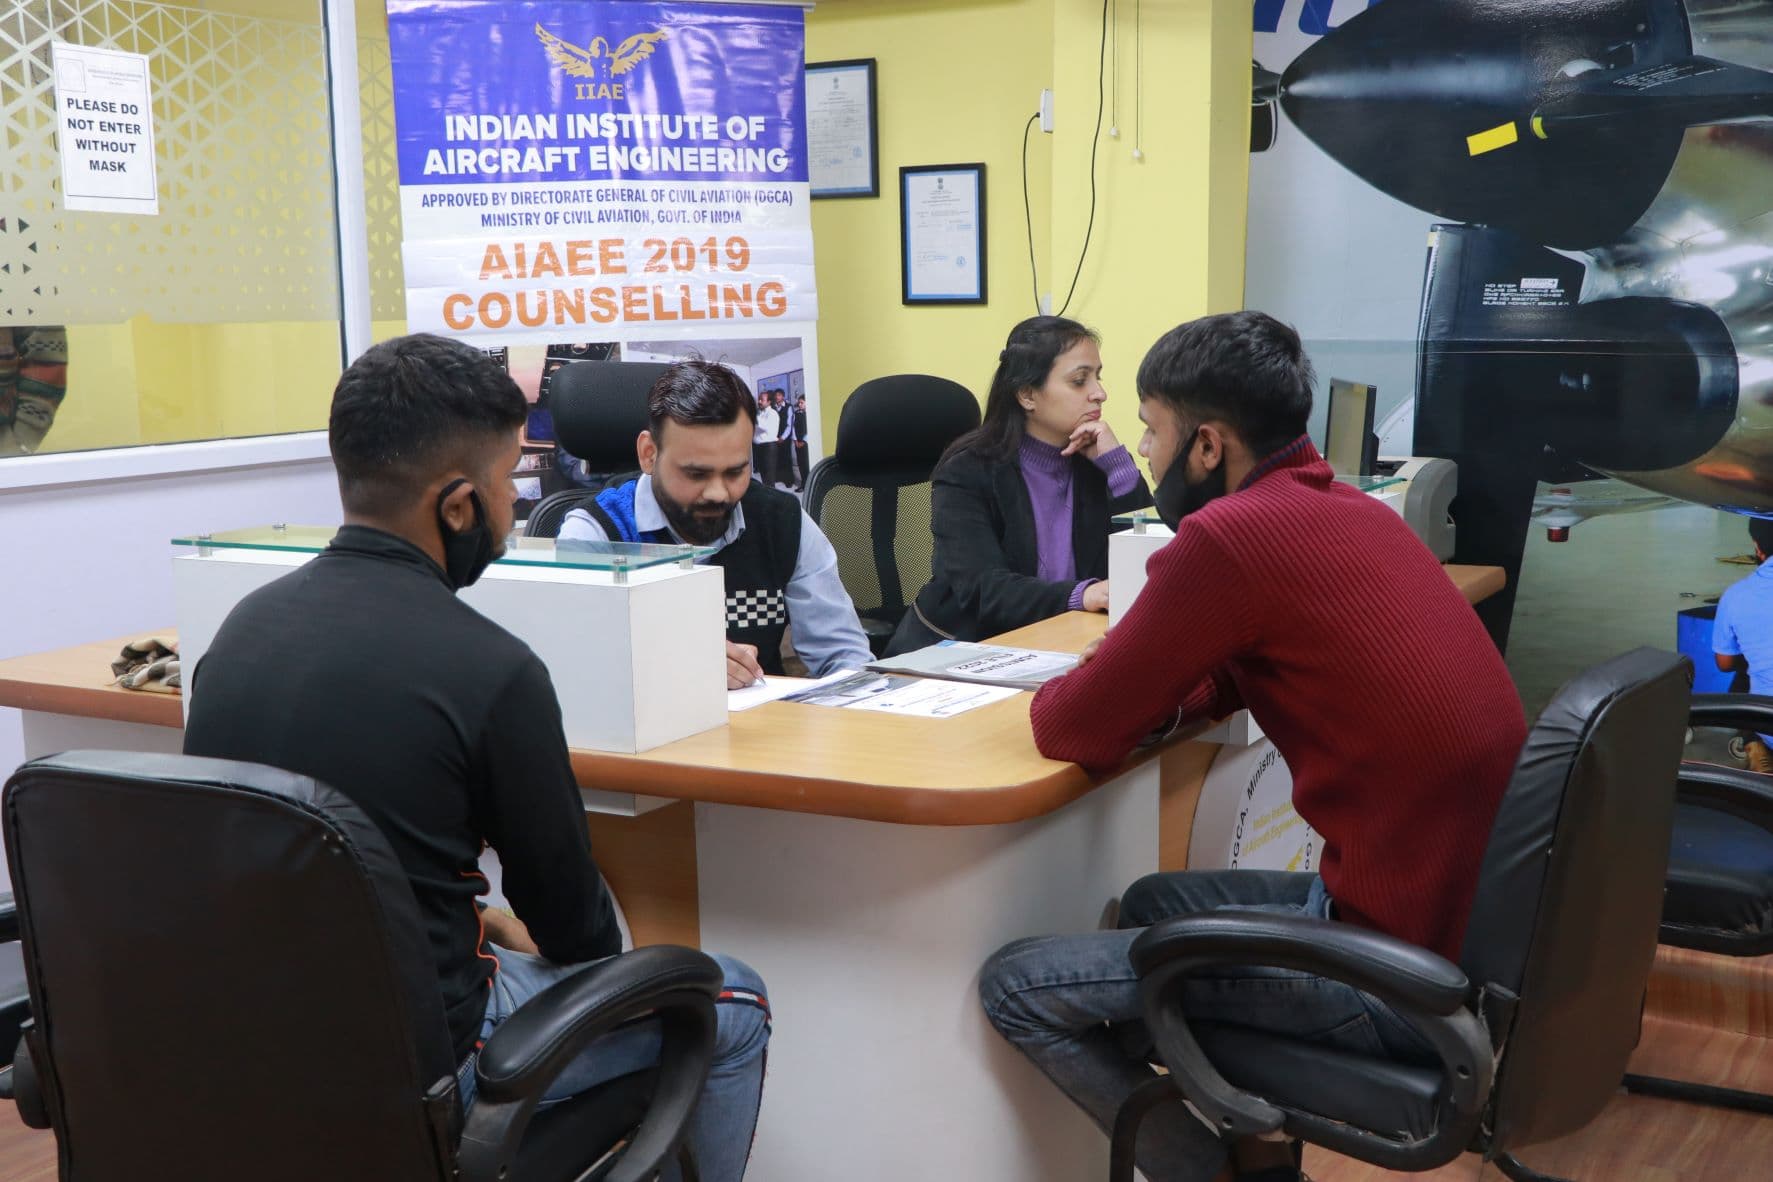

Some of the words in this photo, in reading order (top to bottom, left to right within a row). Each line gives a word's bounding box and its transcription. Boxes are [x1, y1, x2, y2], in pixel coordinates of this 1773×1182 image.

[575, 83, 625, 100] IIAE
[66, 97, 118, 113] PLEASE
[120, 103, 139, 115] DO
[67, 118, 95, 131] NOT
[99, 121, 142, 135] ENTER
[445, 113, 558, 141] INDIAN
[566, 112, 719, 141] INSTITUTE
[726, 115, 766, 141] OF
[75, 138, 137, 154] WITHOUT
[88, 159, 127, 173] MASK
[423, 146, 581, 175] AIRCRAFT
[589, 145, 789, 174] ENGINEERING
[421, 192, 489, 208] APPROVED
[491, 191, 508, 206] BY
[511, 189, 593, 206] DIRECTORATE
[596, 187, 648, 203] GENERAL
[651, 188, 666, 203] OF
[668, 188, 698, 203] CIVIL
[700, 189, 751, 204] AVIATION
[754, 189, 794, 207] (DGCA)
[481, 211, 541, 227] MINISTRY
[544, 211, 560, 225] OF
[563, 210, 594, 225] CIVIL
[597, 208, 655, 225] AVIATION,
[657, 210, 690, 224] GOVT.
[693, 210, 708, 224] OF
[710, 211, 742, 224] INDIA
[478, 238, 628, 280] AIAEE
[643, 235, 751, 273] 2019
[442, 281, 788, 330] COUNSELLING
[1247, 749, 1277, 800] Ministry
